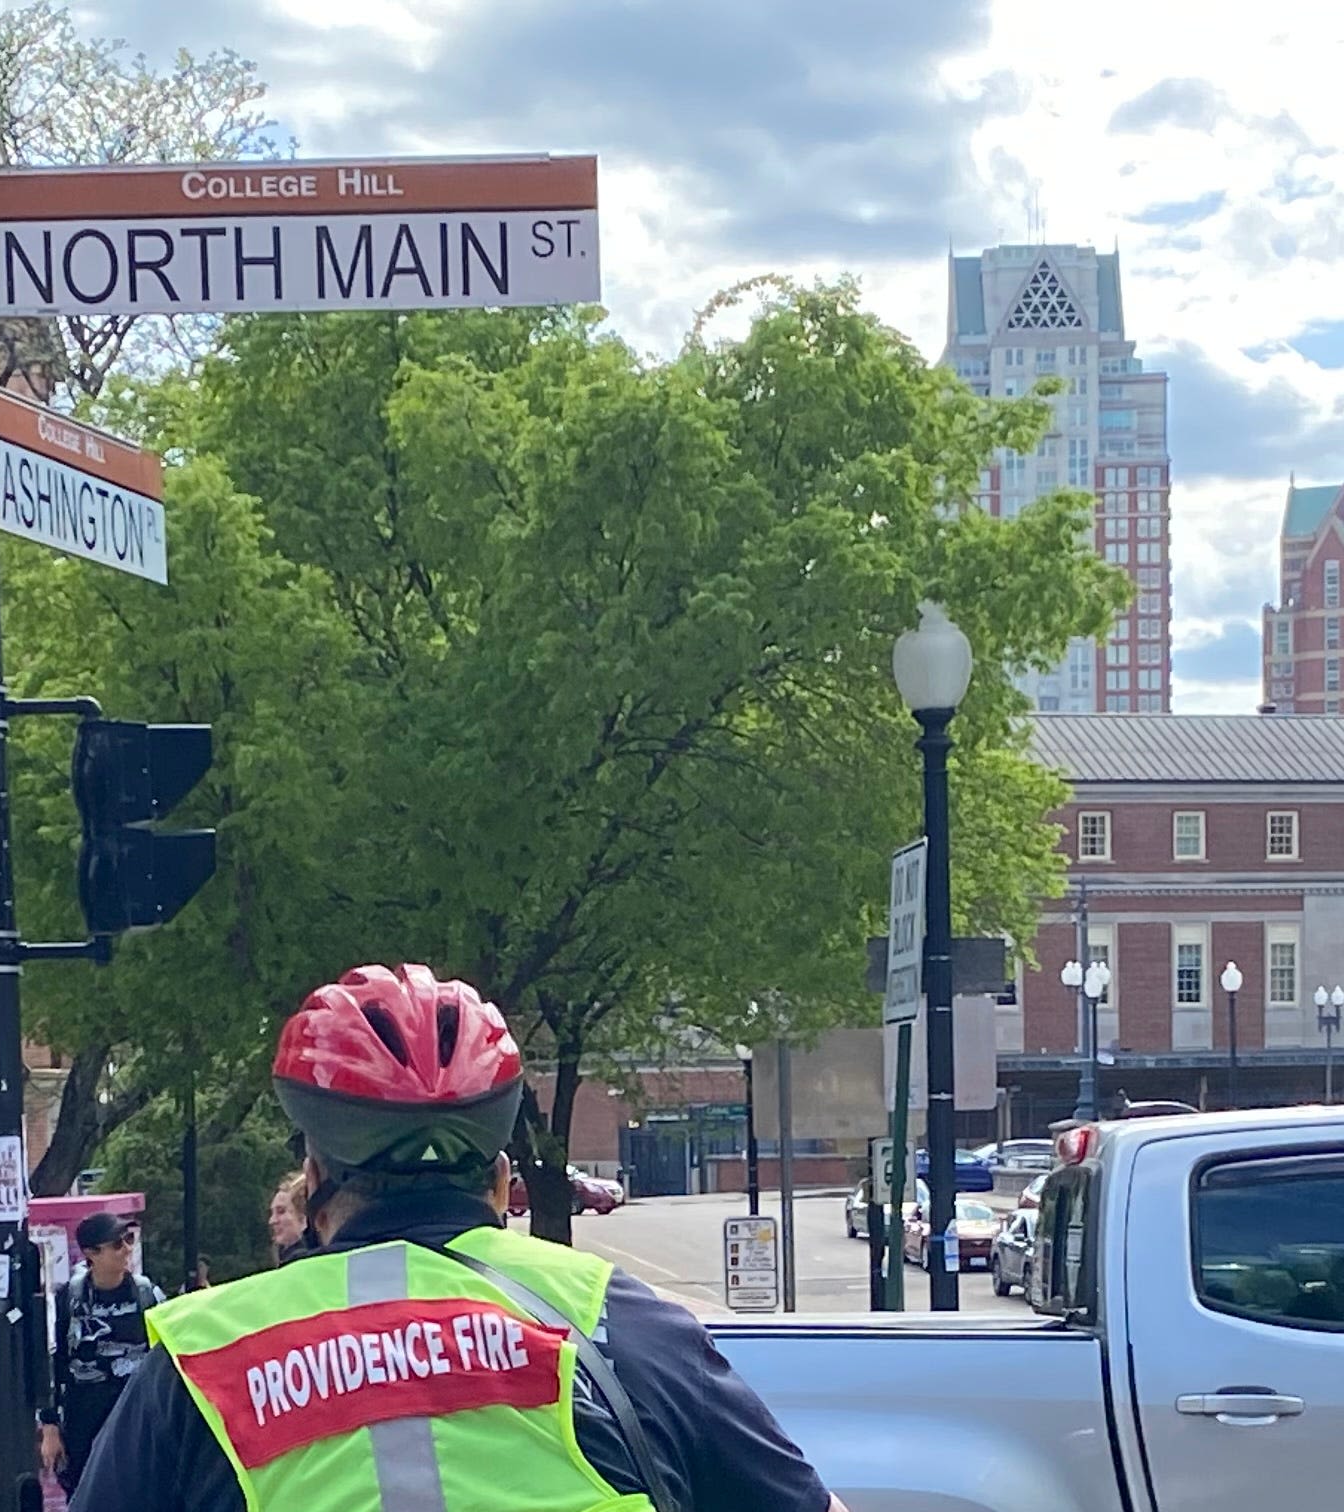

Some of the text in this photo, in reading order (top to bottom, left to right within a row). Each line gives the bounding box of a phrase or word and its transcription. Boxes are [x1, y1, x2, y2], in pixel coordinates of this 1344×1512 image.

[182, 167, 404, 199] COLLEGE HILL
[4, 219, 588, 305] NORTH MAIN ST.
[38, 413, 106, 463] COLLEGE HILL
[247, 1312, 530, 1426] PROVIDENCE FIRE
